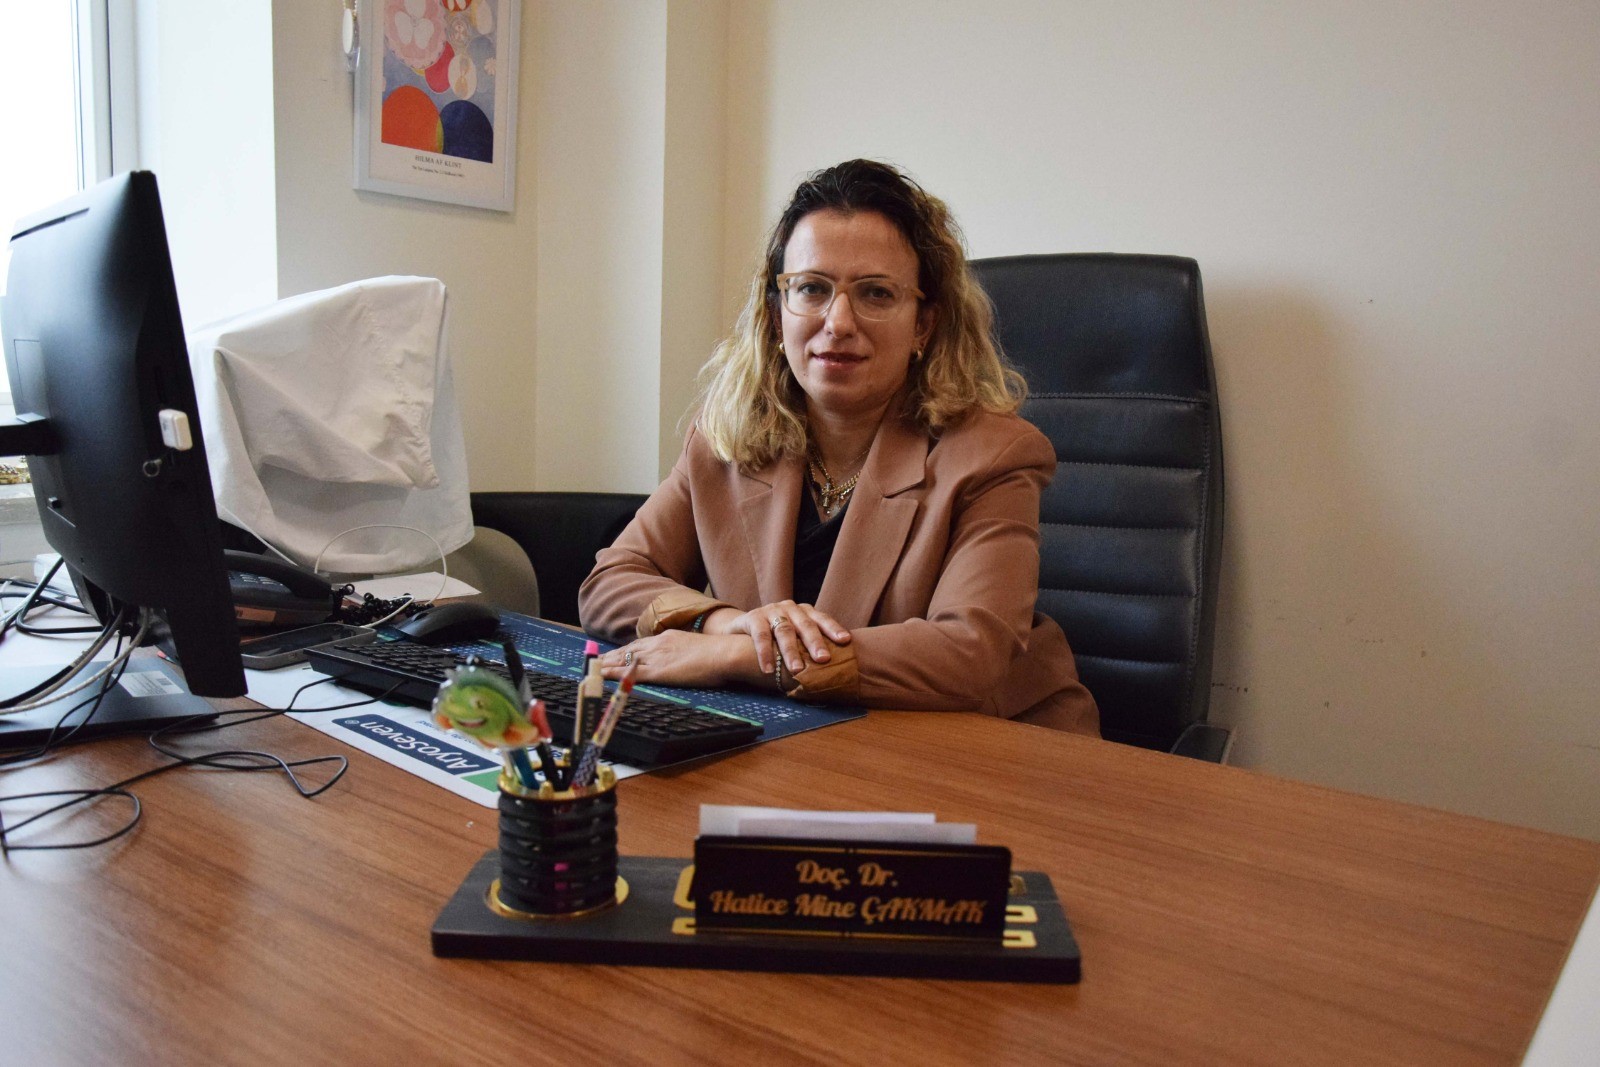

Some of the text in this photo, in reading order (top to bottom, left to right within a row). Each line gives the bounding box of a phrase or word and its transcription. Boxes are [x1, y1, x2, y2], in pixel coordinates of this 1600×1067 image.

[415, 154, 434, 164] HILMA
[796, 859, 898, 890] Doç. Dr.
[710, 889, 986, 925] Hatice Mine ÇAKMAK
